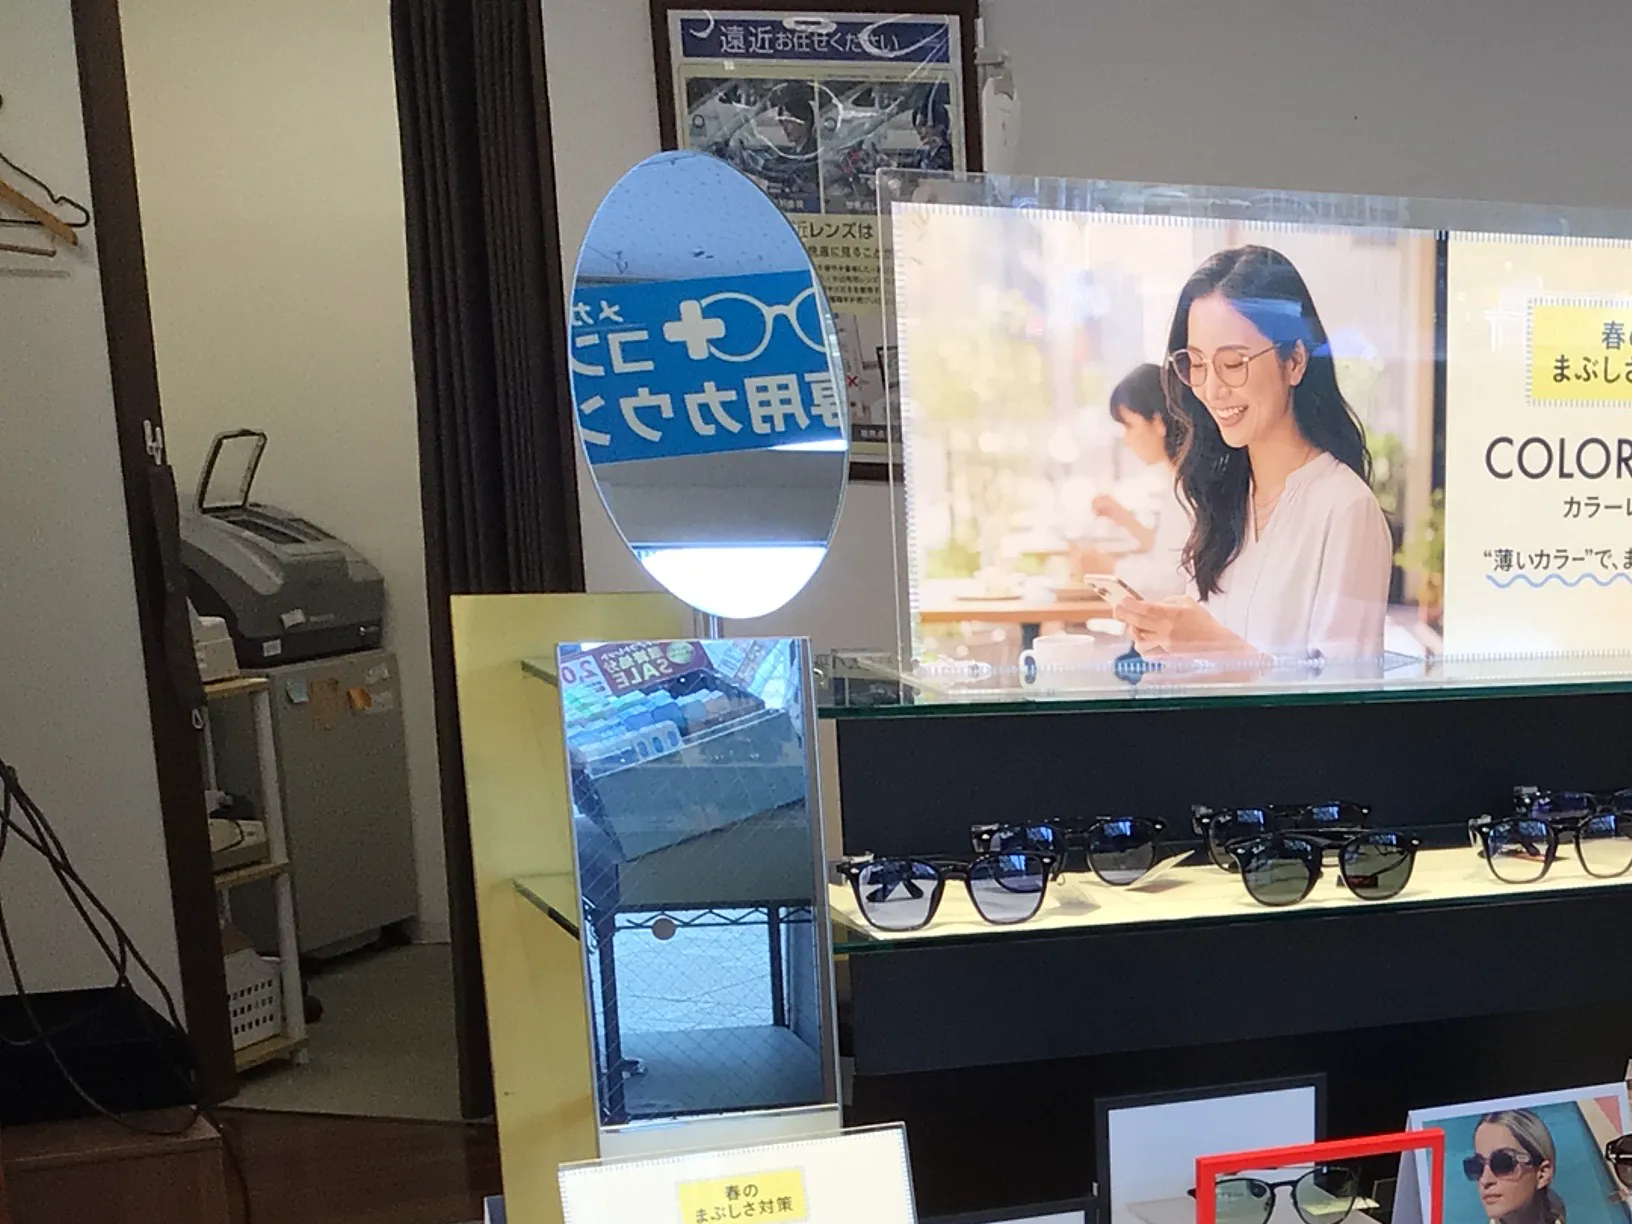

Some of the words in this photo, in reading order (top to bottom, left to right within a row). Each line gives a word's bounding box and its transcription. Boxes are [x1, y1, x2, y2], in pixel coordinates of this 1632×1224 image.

[724, 1182, 759, 1201] 春の
[694, 1196, 794, 1224] まぶしさ対策
